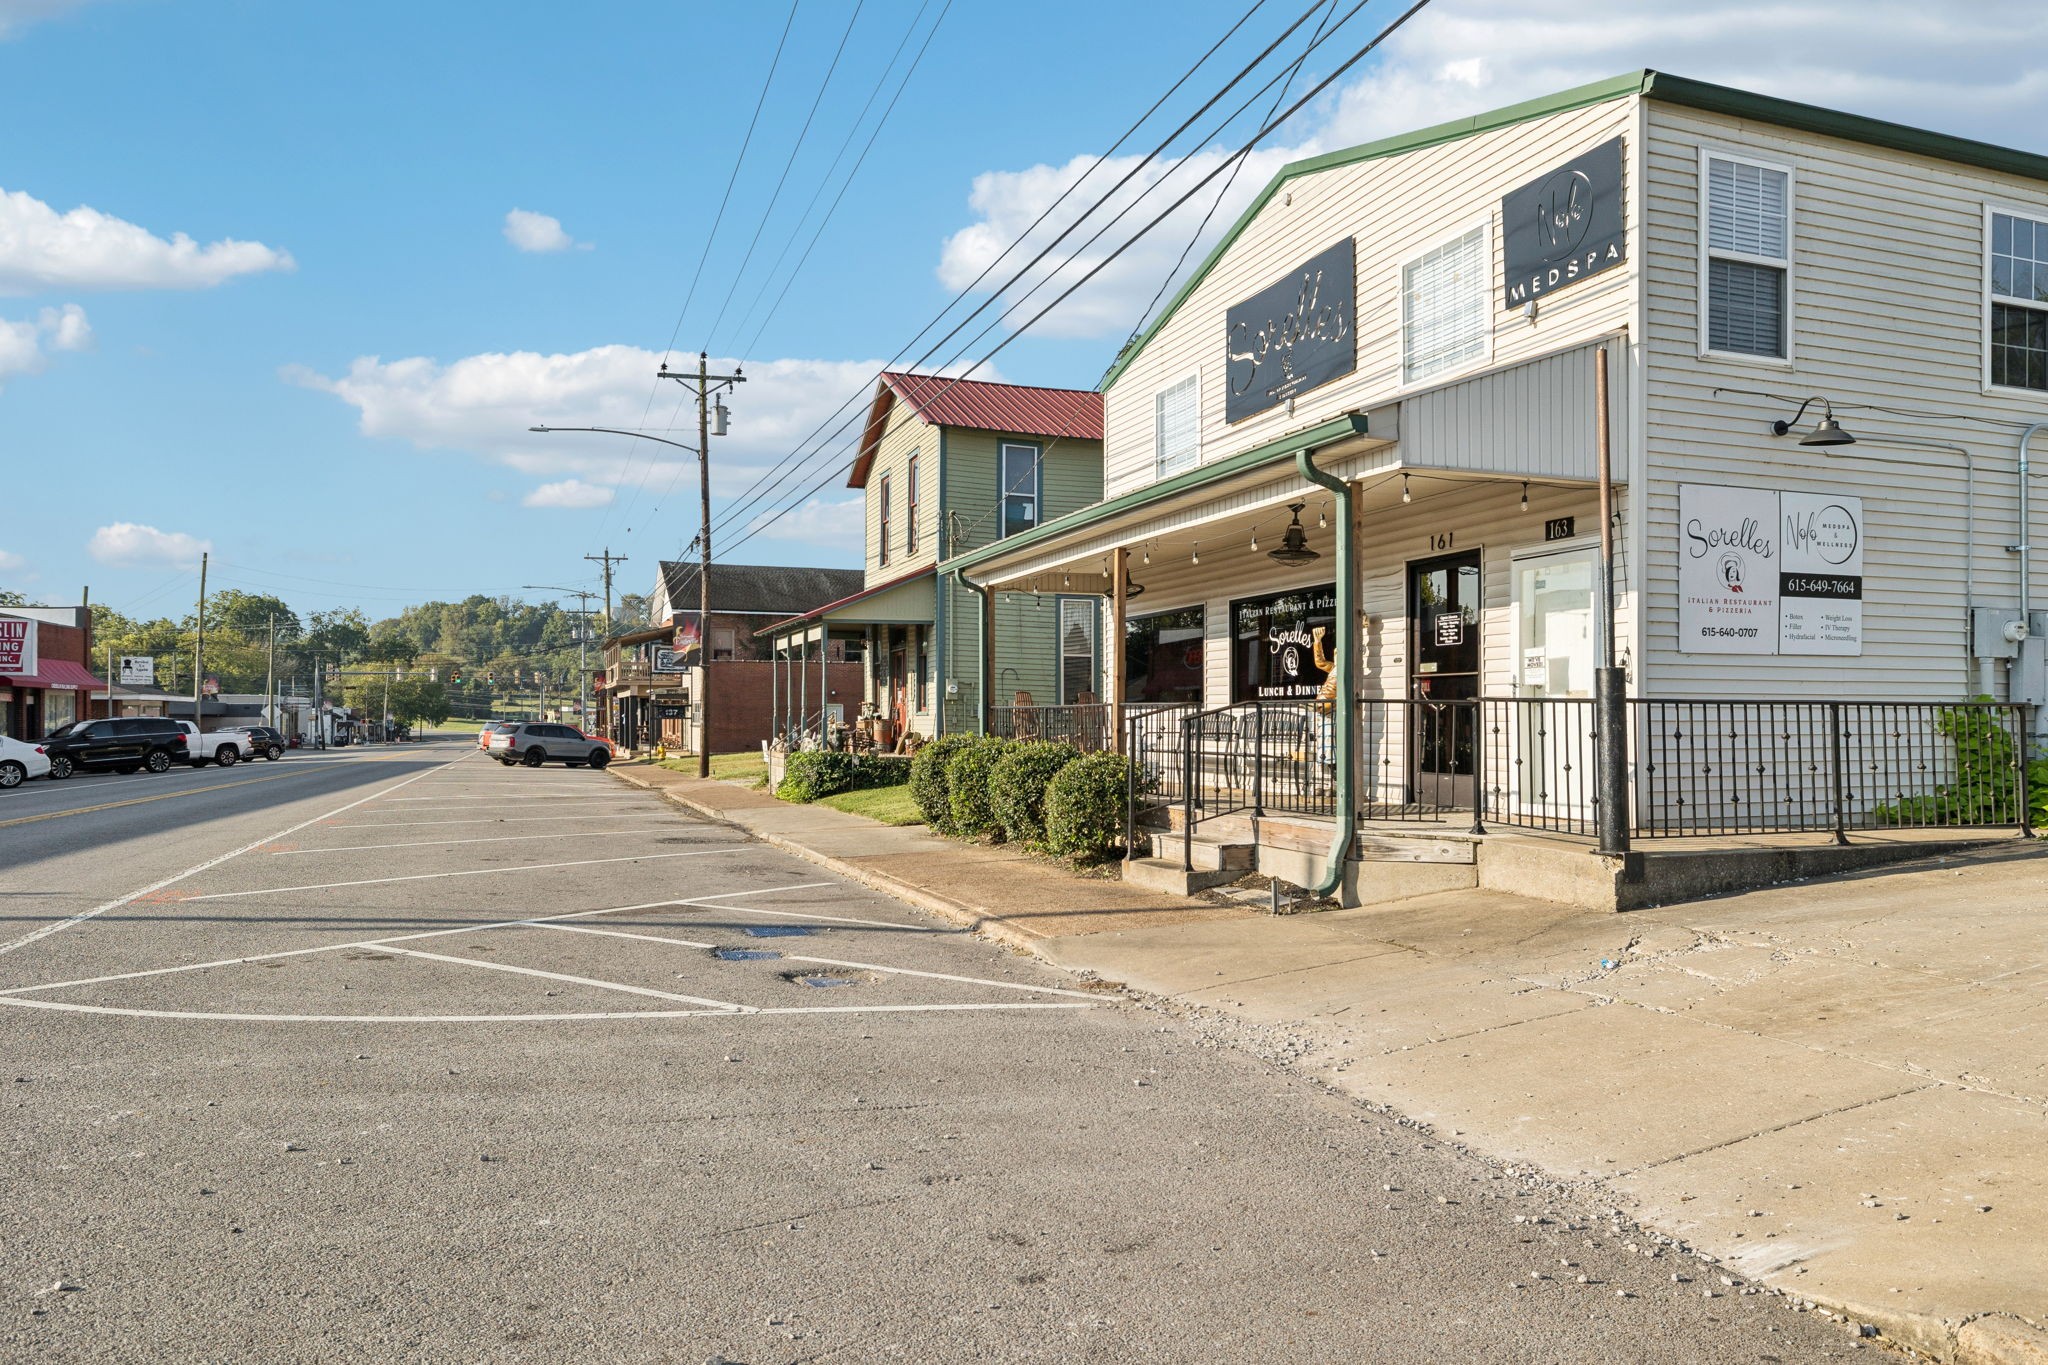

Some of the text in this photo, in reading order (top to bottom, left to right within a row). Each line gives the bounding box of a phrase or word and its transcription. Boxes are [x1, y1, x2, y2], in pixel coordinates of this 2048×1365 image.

[1508, 242, 1618, 303] MEDSPA
[1228, 270, 1351, 397] Sorelles
[1550, 519, 1568, 539] 163
[1687, 517, 1774, 559] Sorelles
[1430, 532, 1453, 551] 161
[1816, 541, 1853, 549] WELLNESS
[1788, 578, 1855, 595] 615-649-7664
[1265, 601, 1307, 616] RESTAURANT
[1309, 600, 1314, 609] &
[1717, 606, 1752, 614] PIZZERIA
[1269, 620, 1313, 654] Sorelles
[1701, 627, 1758, 638] 615-640-0707
[1258, 684, 1324, 697] LUNCH & DINNE
